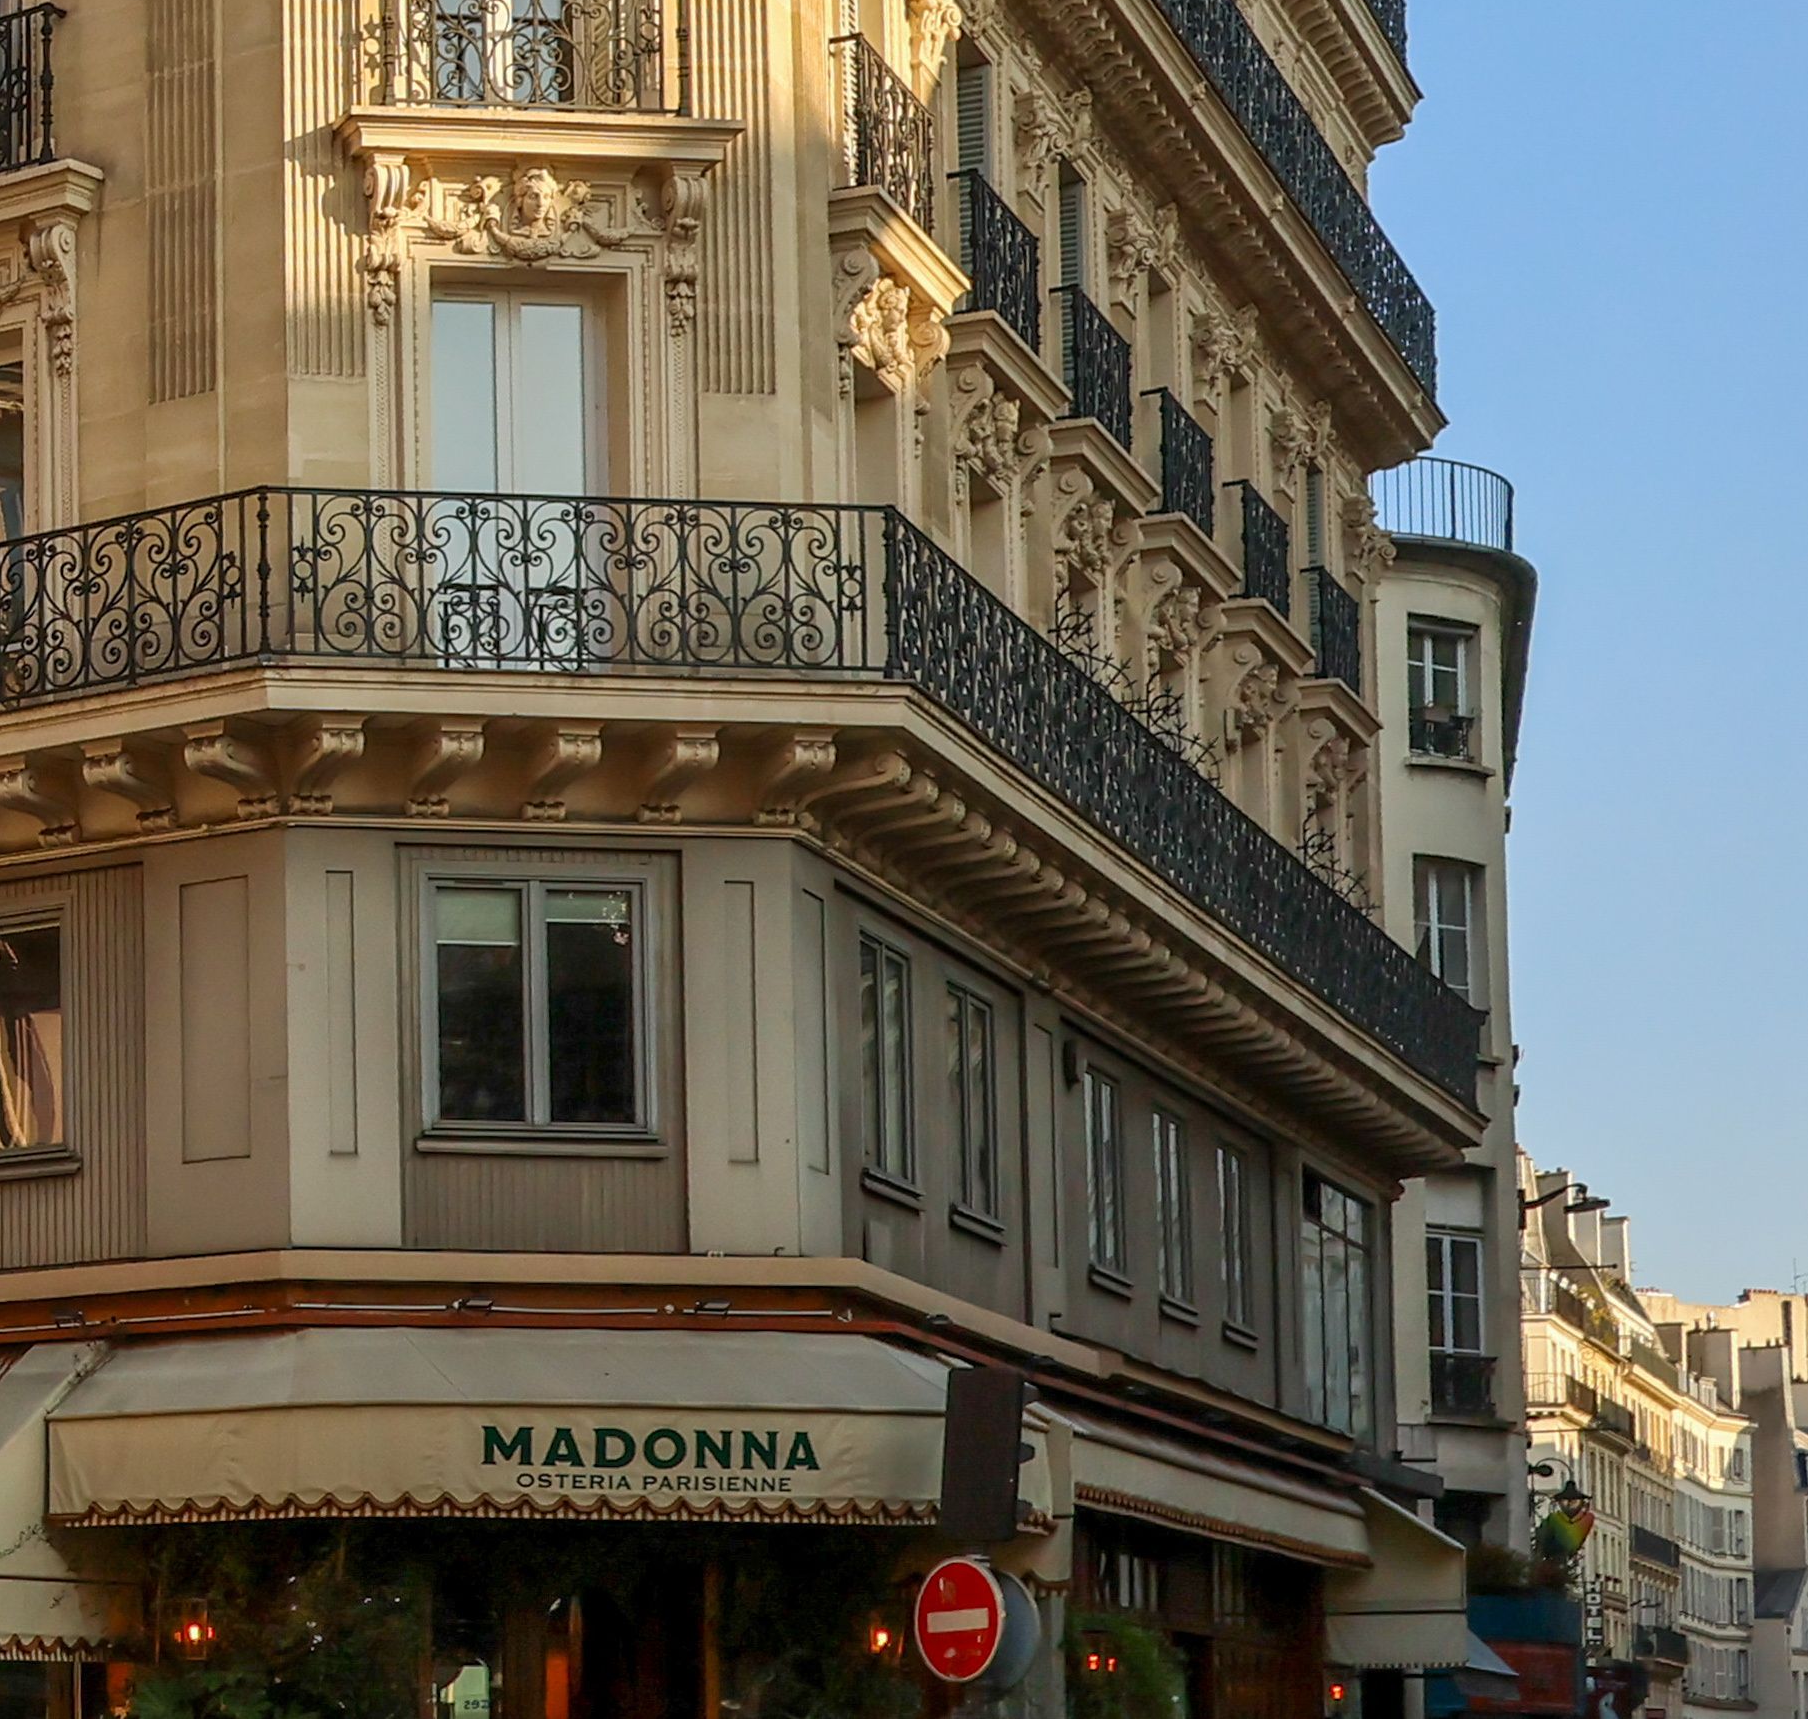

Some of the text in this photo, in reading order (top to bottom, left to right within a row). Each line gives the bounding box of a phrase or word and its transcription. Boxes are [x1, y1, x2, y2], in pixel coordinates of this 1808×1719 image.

[481, 1426, 821, 1471] MADONNA
[516, 1473, 792, 1492] OSTERIA PARISIENNE
[1585, 1581, 1603, 1641] HOTEL
